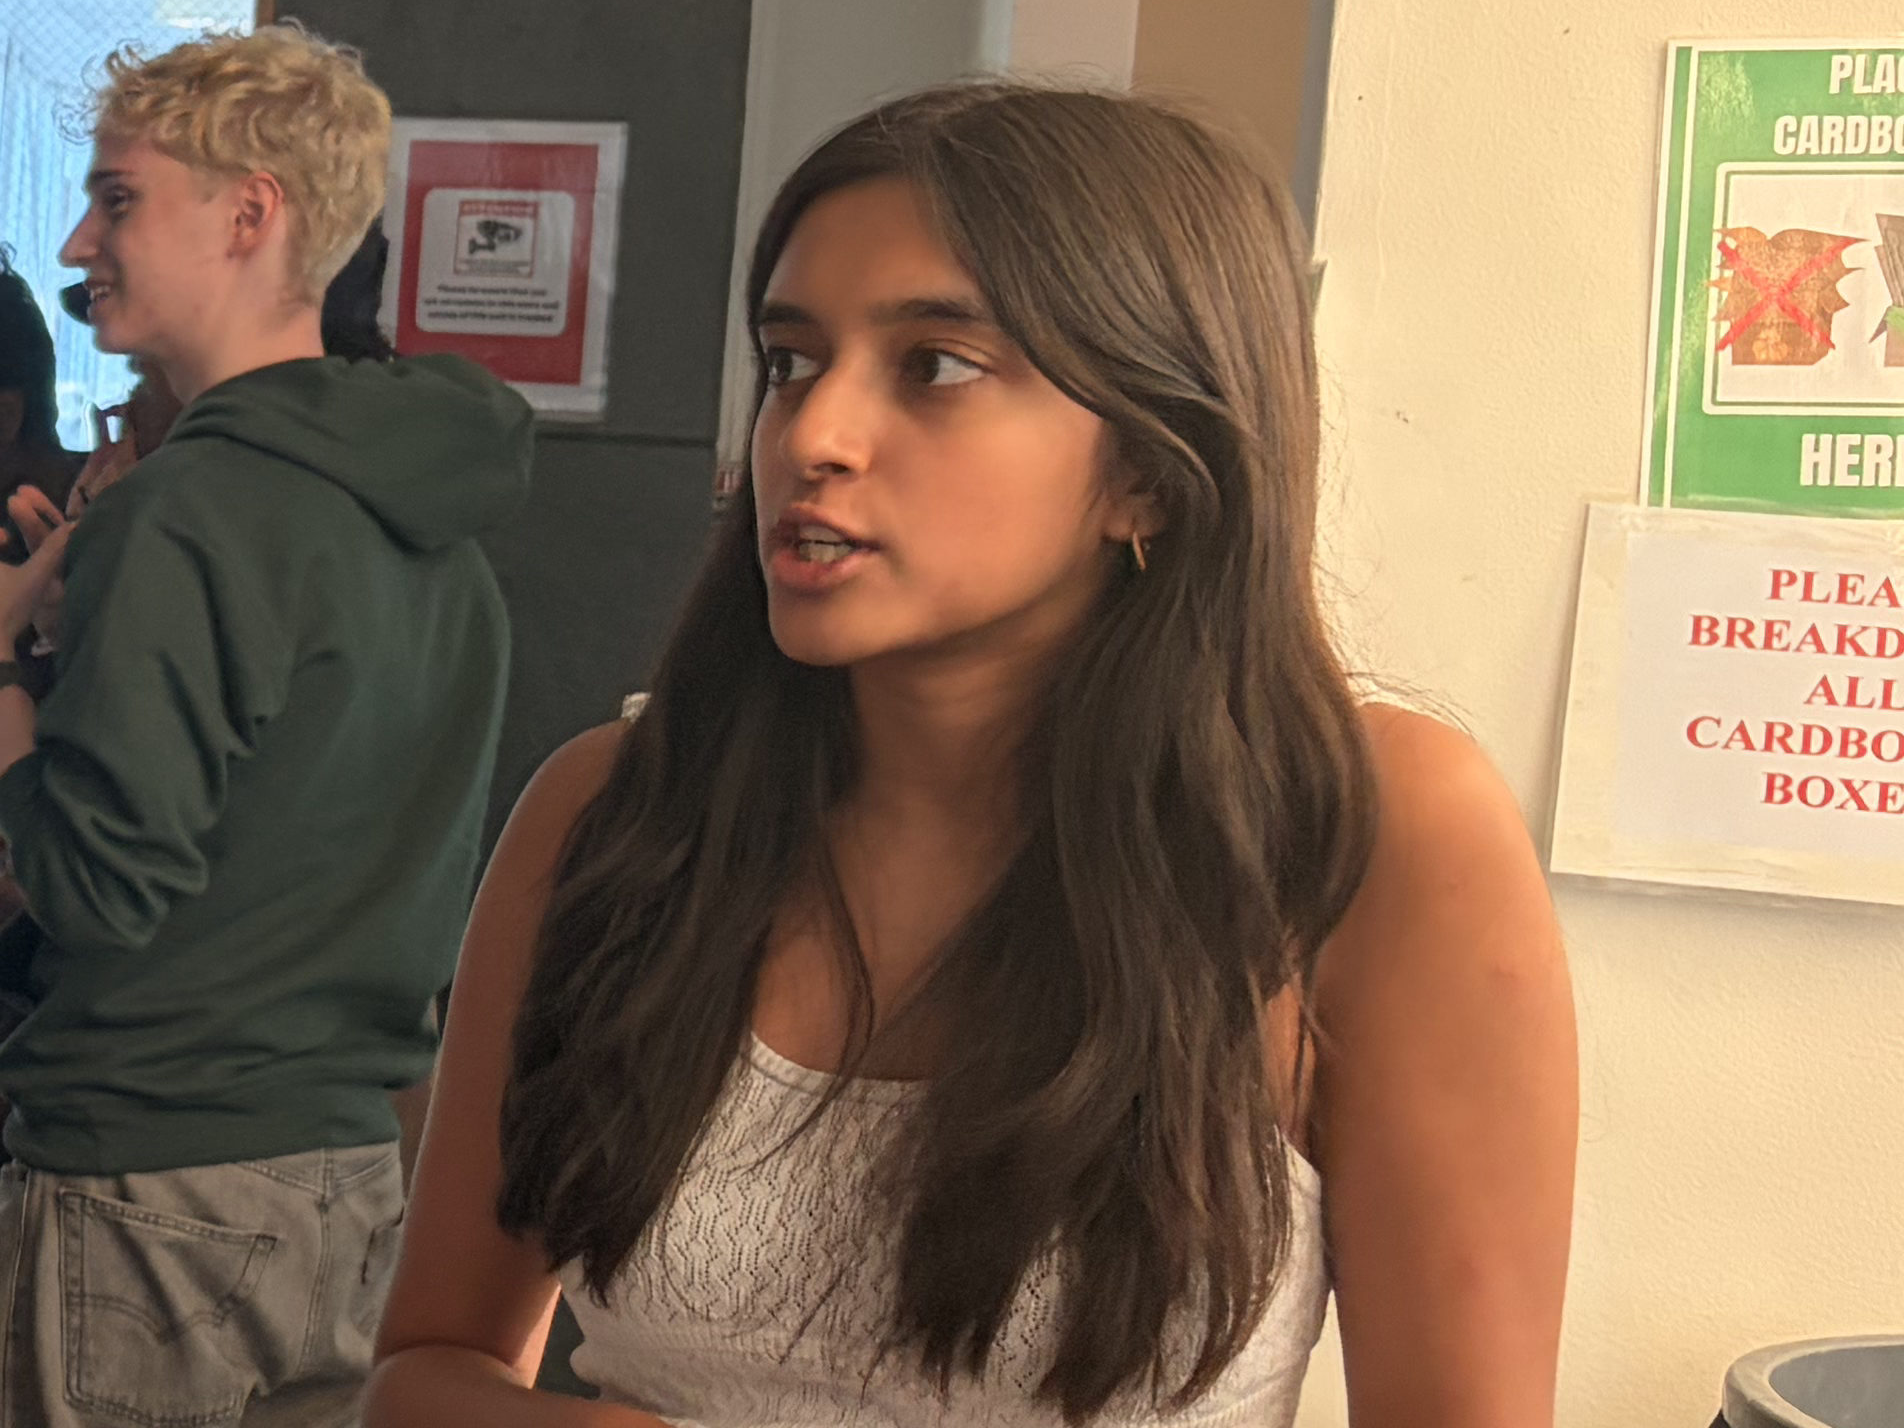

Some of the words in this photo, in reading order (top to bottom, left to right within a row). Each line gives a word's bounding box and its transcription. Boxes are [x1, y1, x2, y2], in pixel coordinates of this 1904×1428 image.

[1766, 568, 1903, 608] PLEA
[1688, 614, 1904, 660] BREAKD
[1803, 674, 1904, 711] ALL
[1686, 716, 1904, 763] CARDBO
[1760, 772, 1904, 815] BOXE
